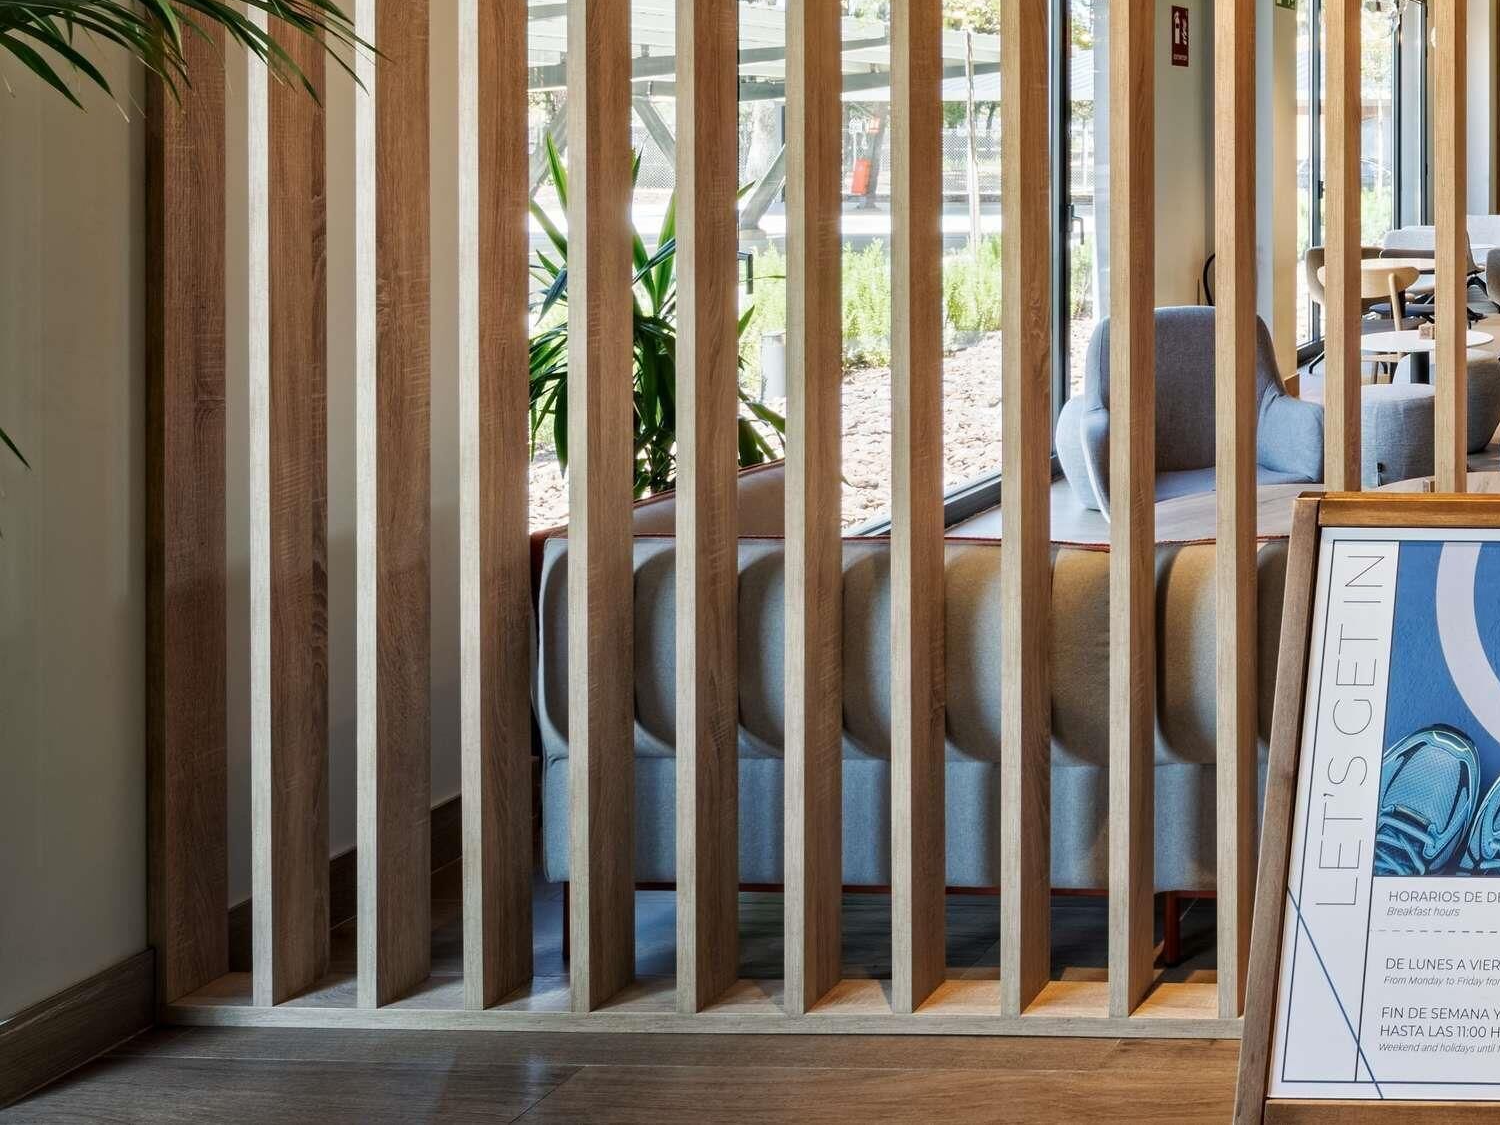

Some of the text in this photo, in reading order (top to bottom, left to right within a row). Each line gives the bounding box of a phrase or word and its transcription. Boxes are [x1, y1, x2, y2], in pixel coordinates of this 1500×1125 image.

[1315, 555, 1385, 906] LET'S GET IN
[1388, 890, 1460, 903] HORARIOS
[1464, 891, 1483, 903] DE
[1386, 906, 1461, 917] Breakfast hours
[1385, 958, 1405, 970] DE
[1408, 958, 1453, 971] LUNES
[1456, 959, 1466, 970] A
[1384, 975, 1406, 985] From
[1408, 976, 1444, 987] Monday
[1446, 977, 1455, 985] to
[1457, 976, 1483, 987] Friday
[1381, 1007, 1404, 1019] FIN
[1408, 1007, 1427, 1019] DE
[1431, 1007, 1489, 1020] SEMANA
[1380, 1025, 1424, 1037] HASTA
[1428, 1026, 1454, 1037] LAS
[1457, 1026, 1487, 1038] 11:00
[1378, 1042, 1420, 1052] Weekend
[1421, 1043, 1438, 1052] and
[1440, 1043, 1475, 1054] holidays
[1477, 1043, 1495, 1053] until
